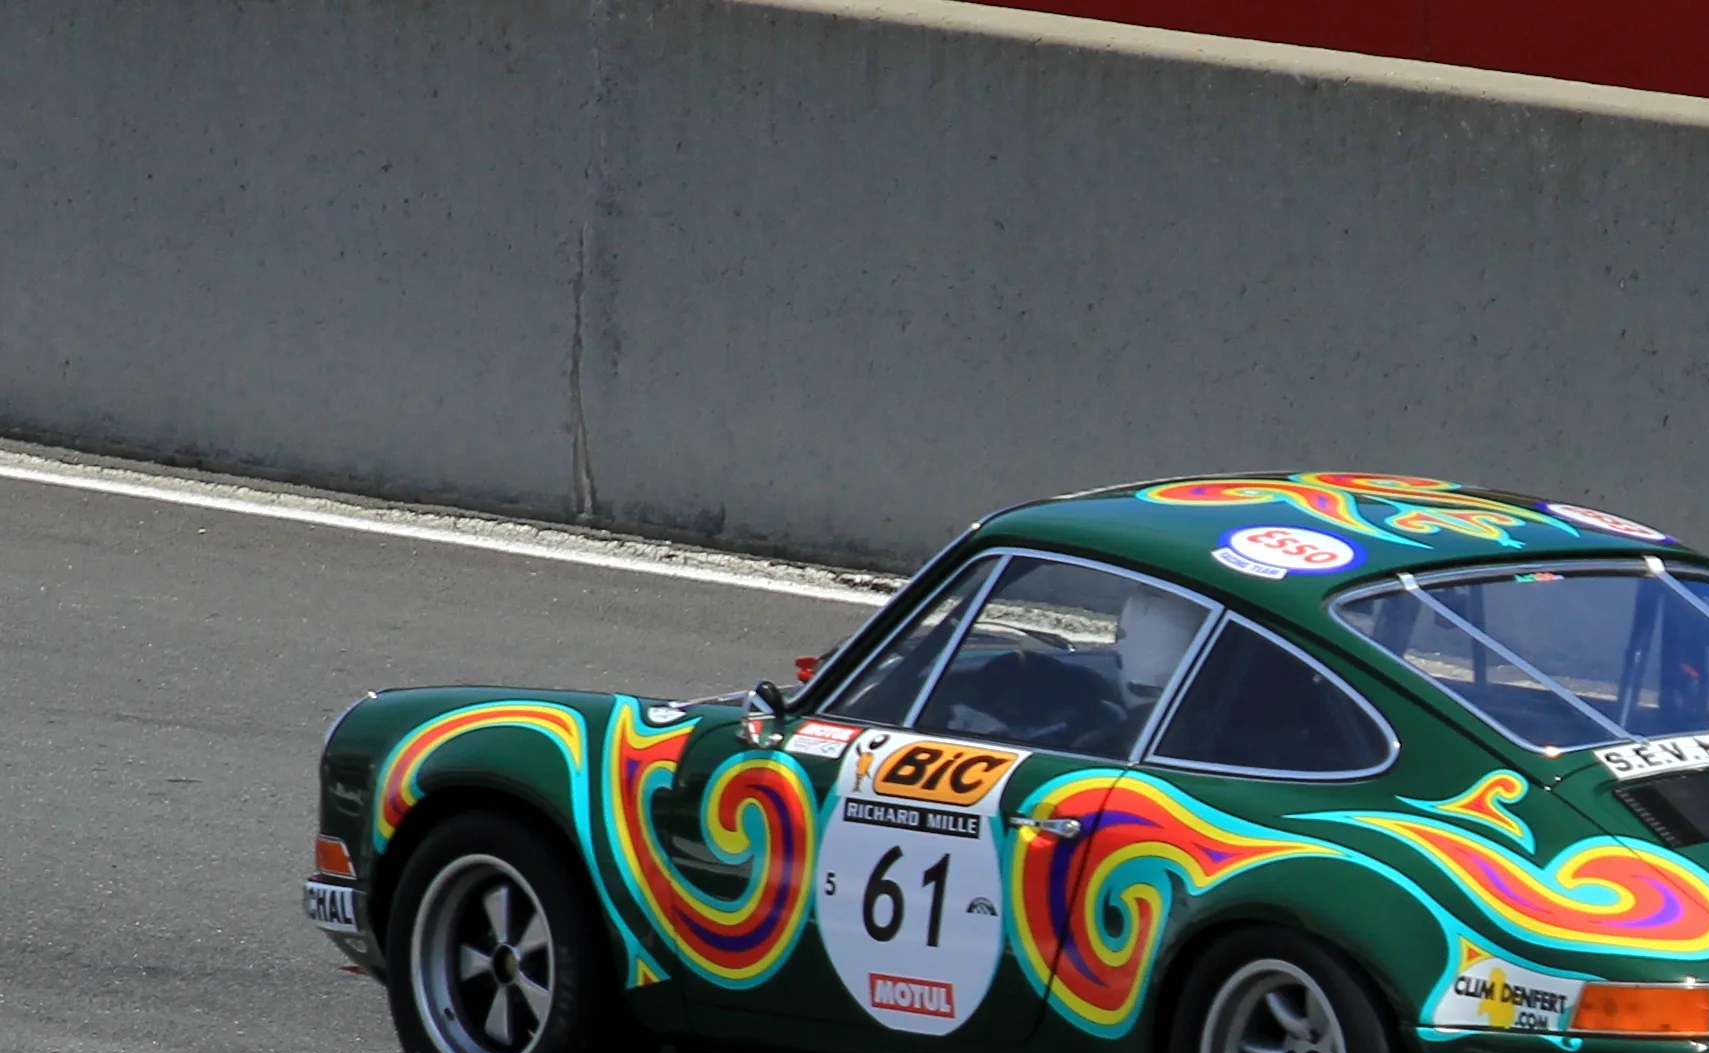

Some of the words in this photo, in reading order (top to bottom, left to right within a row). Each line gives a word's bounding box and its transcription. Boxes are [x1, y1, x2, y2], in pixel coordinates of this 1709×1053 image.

[1246, 530, 1339, 564] ESSO
[847, 802, 920, 826] RICHARD
[926, 813, 977, 834] MILLE
[824, 872, 837, 896] 5
[862, 845, 951, 948] 61
[873, 980, 952, 1013] MOTUL
